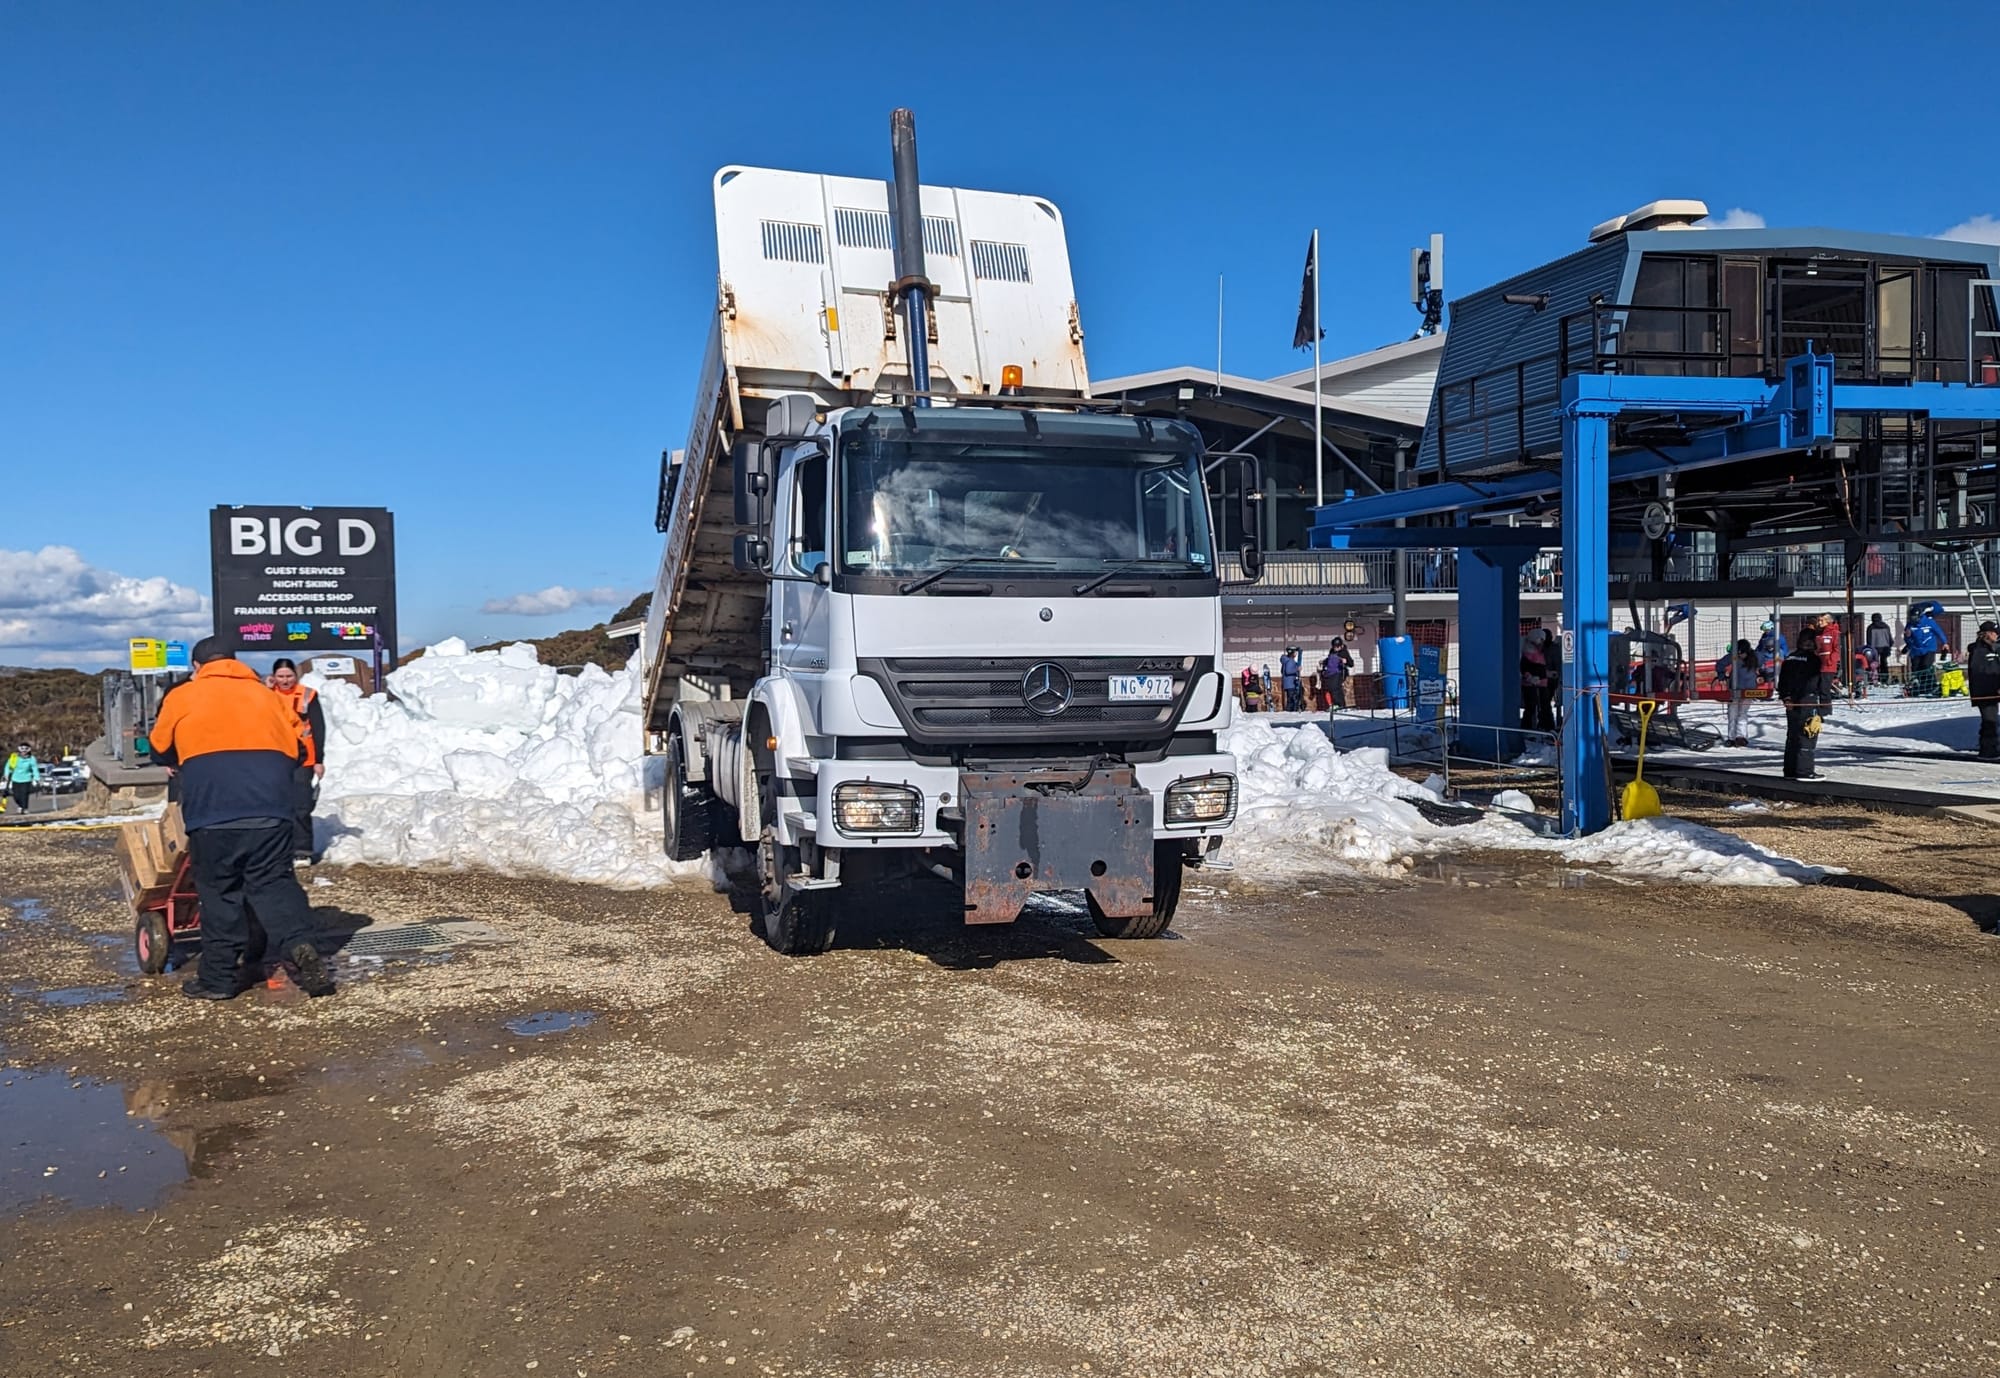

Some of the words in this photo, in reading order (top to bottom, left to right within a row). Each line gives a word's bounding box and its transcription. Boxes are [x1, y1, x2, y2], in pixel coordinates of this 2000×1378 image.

[230, 517, 322, 556] BIG
[338, 518, 376, 556] D
[264, 567, 297, 575] GUEST
[299, 567, 346, 575] SERVICES
[273, 580, 304, 588] NIGHT
[305, 580, 338, 588] SKIING
[258, 594, 325, 602] ACCESSORIES
[326, 594, 354, 602] SHOP
[234, 607, 278, 615] FRANKIE
[279, 605, 304, 615] CAFÉ
[315, 606, 377, 615] RESTAURANT
[239, 623, 274, 634] mighty
[287, 622, 311, 633] KIDS
[1112, 679, 1136, 694] TNG
[1146, 679, 1170, 694] 972
